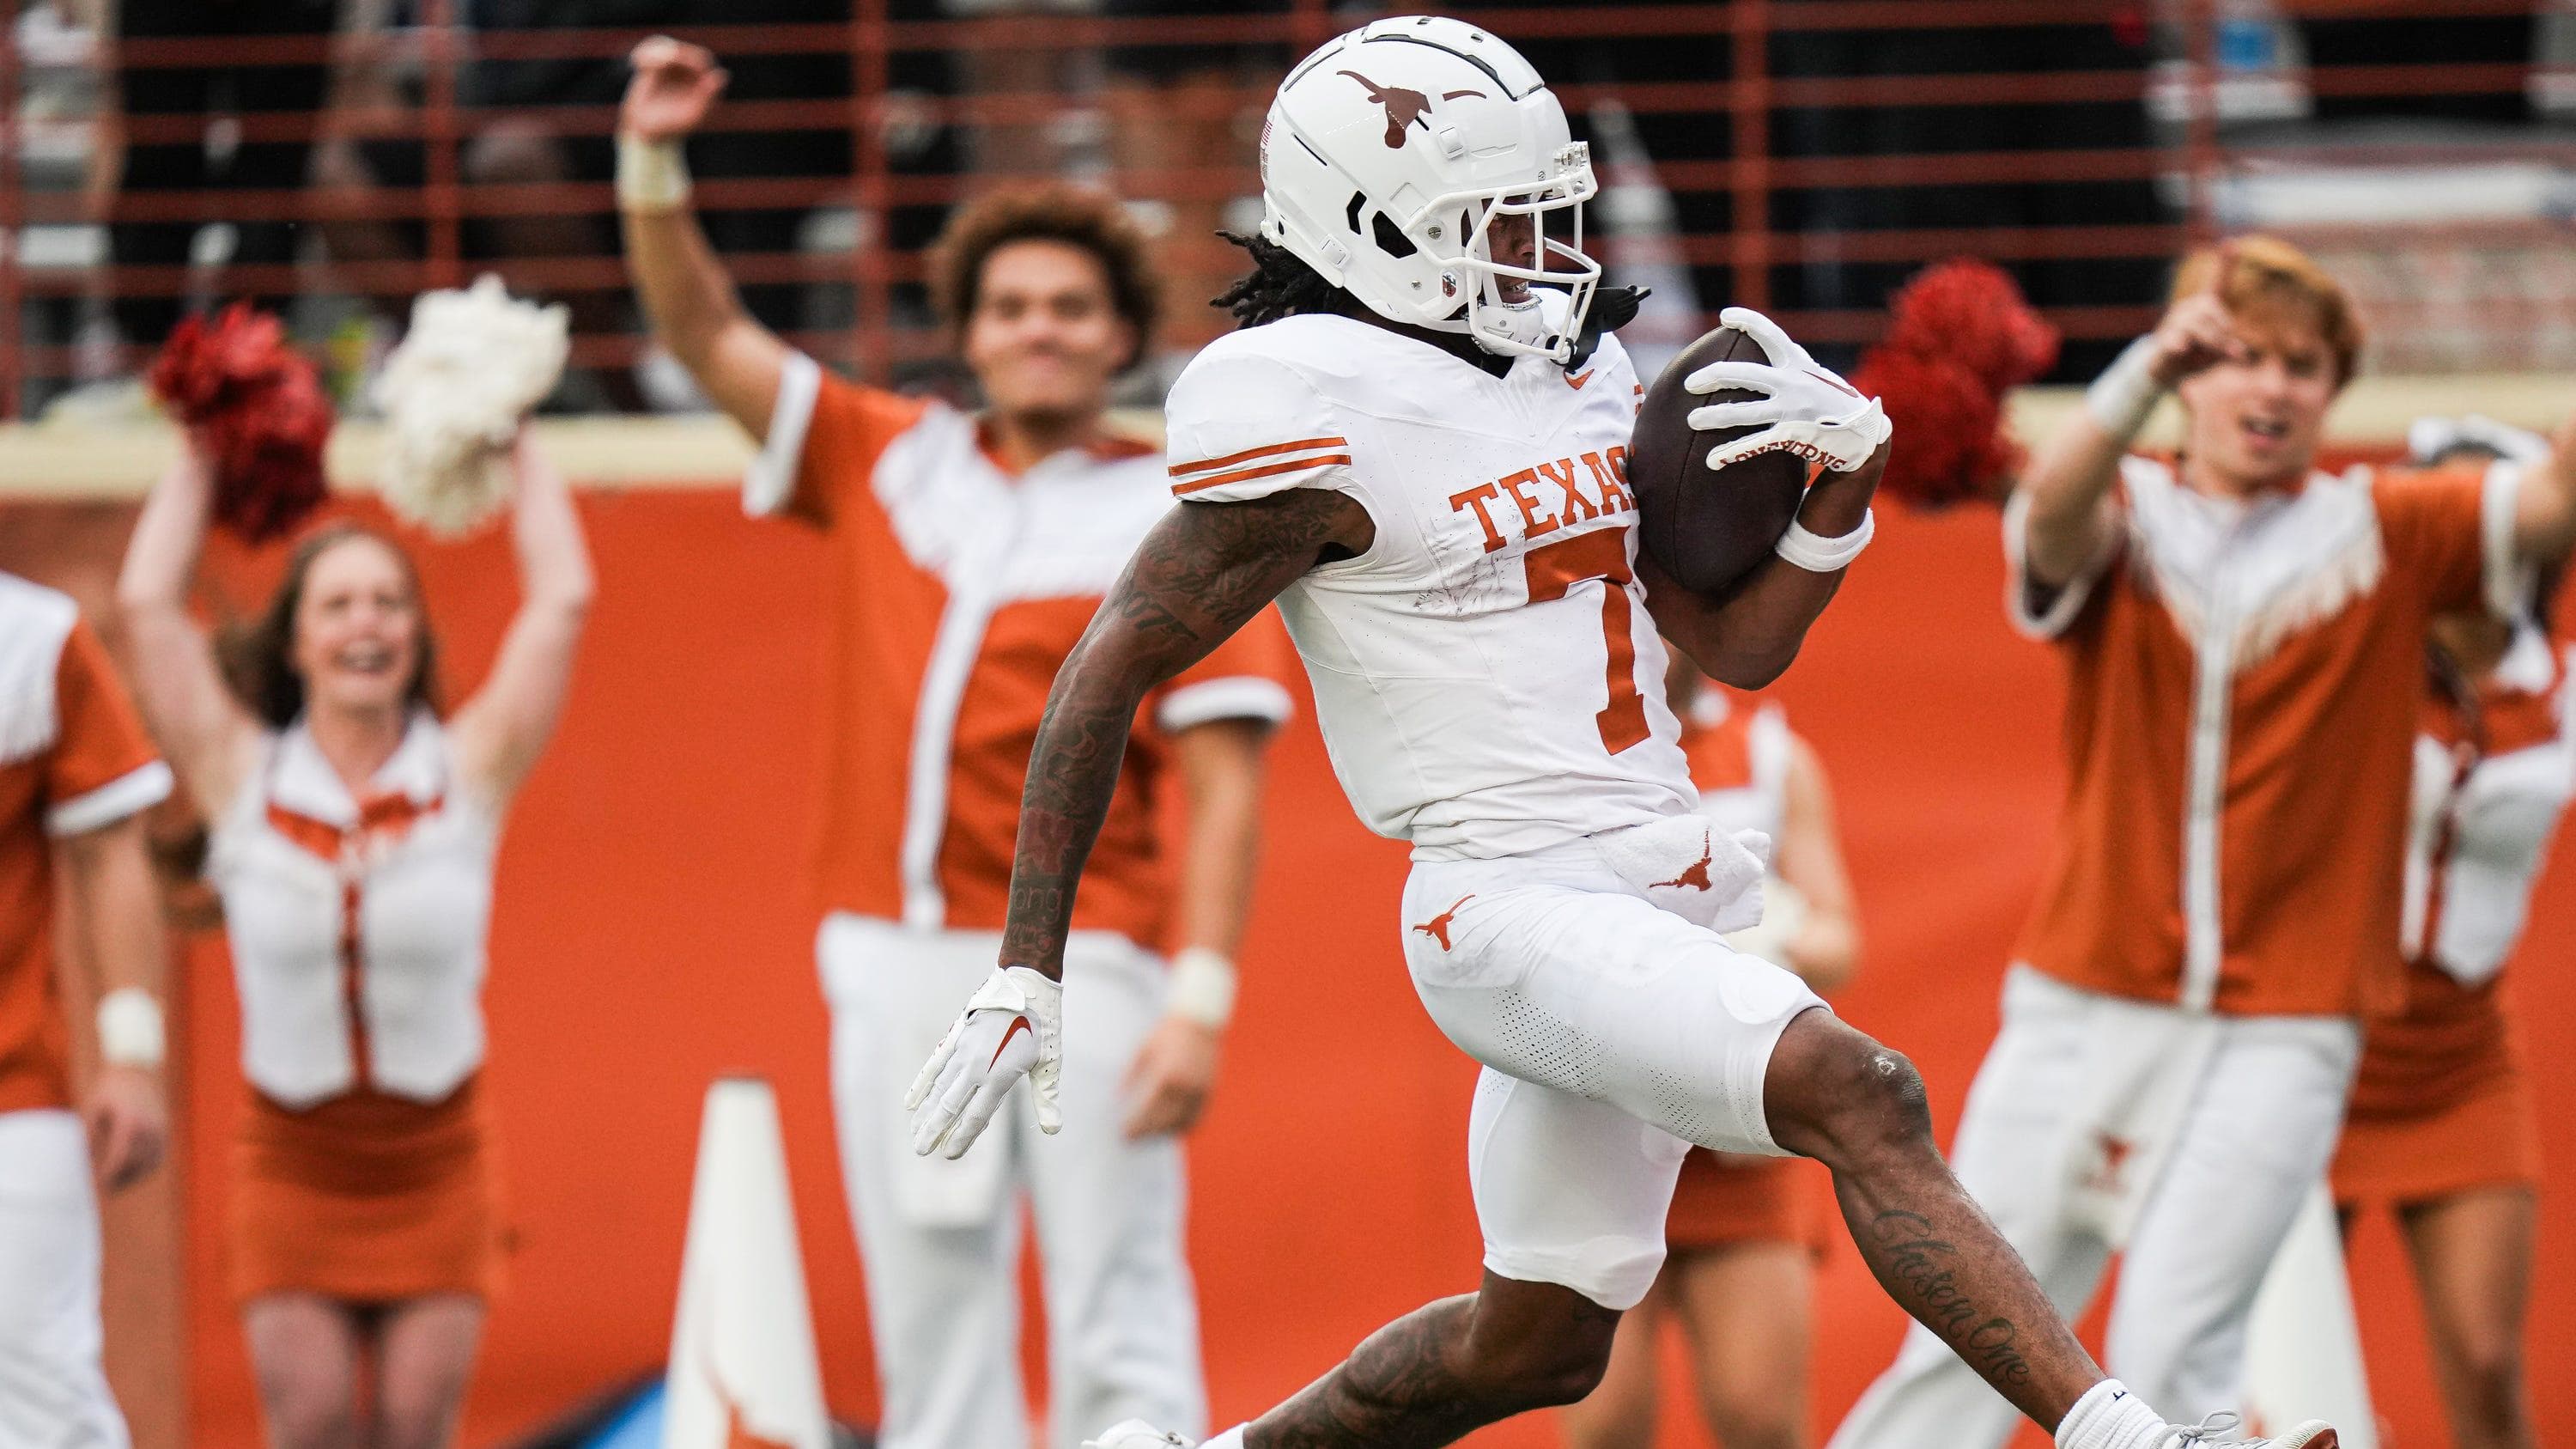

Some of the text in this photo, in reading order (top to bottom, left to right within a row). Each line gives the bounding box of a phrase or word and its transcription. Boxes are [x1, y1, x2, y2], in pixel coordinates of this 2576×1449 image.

[1524, 526, 1651, 756] 7
[1872, 1209, 2029, 1385] Chosen One
